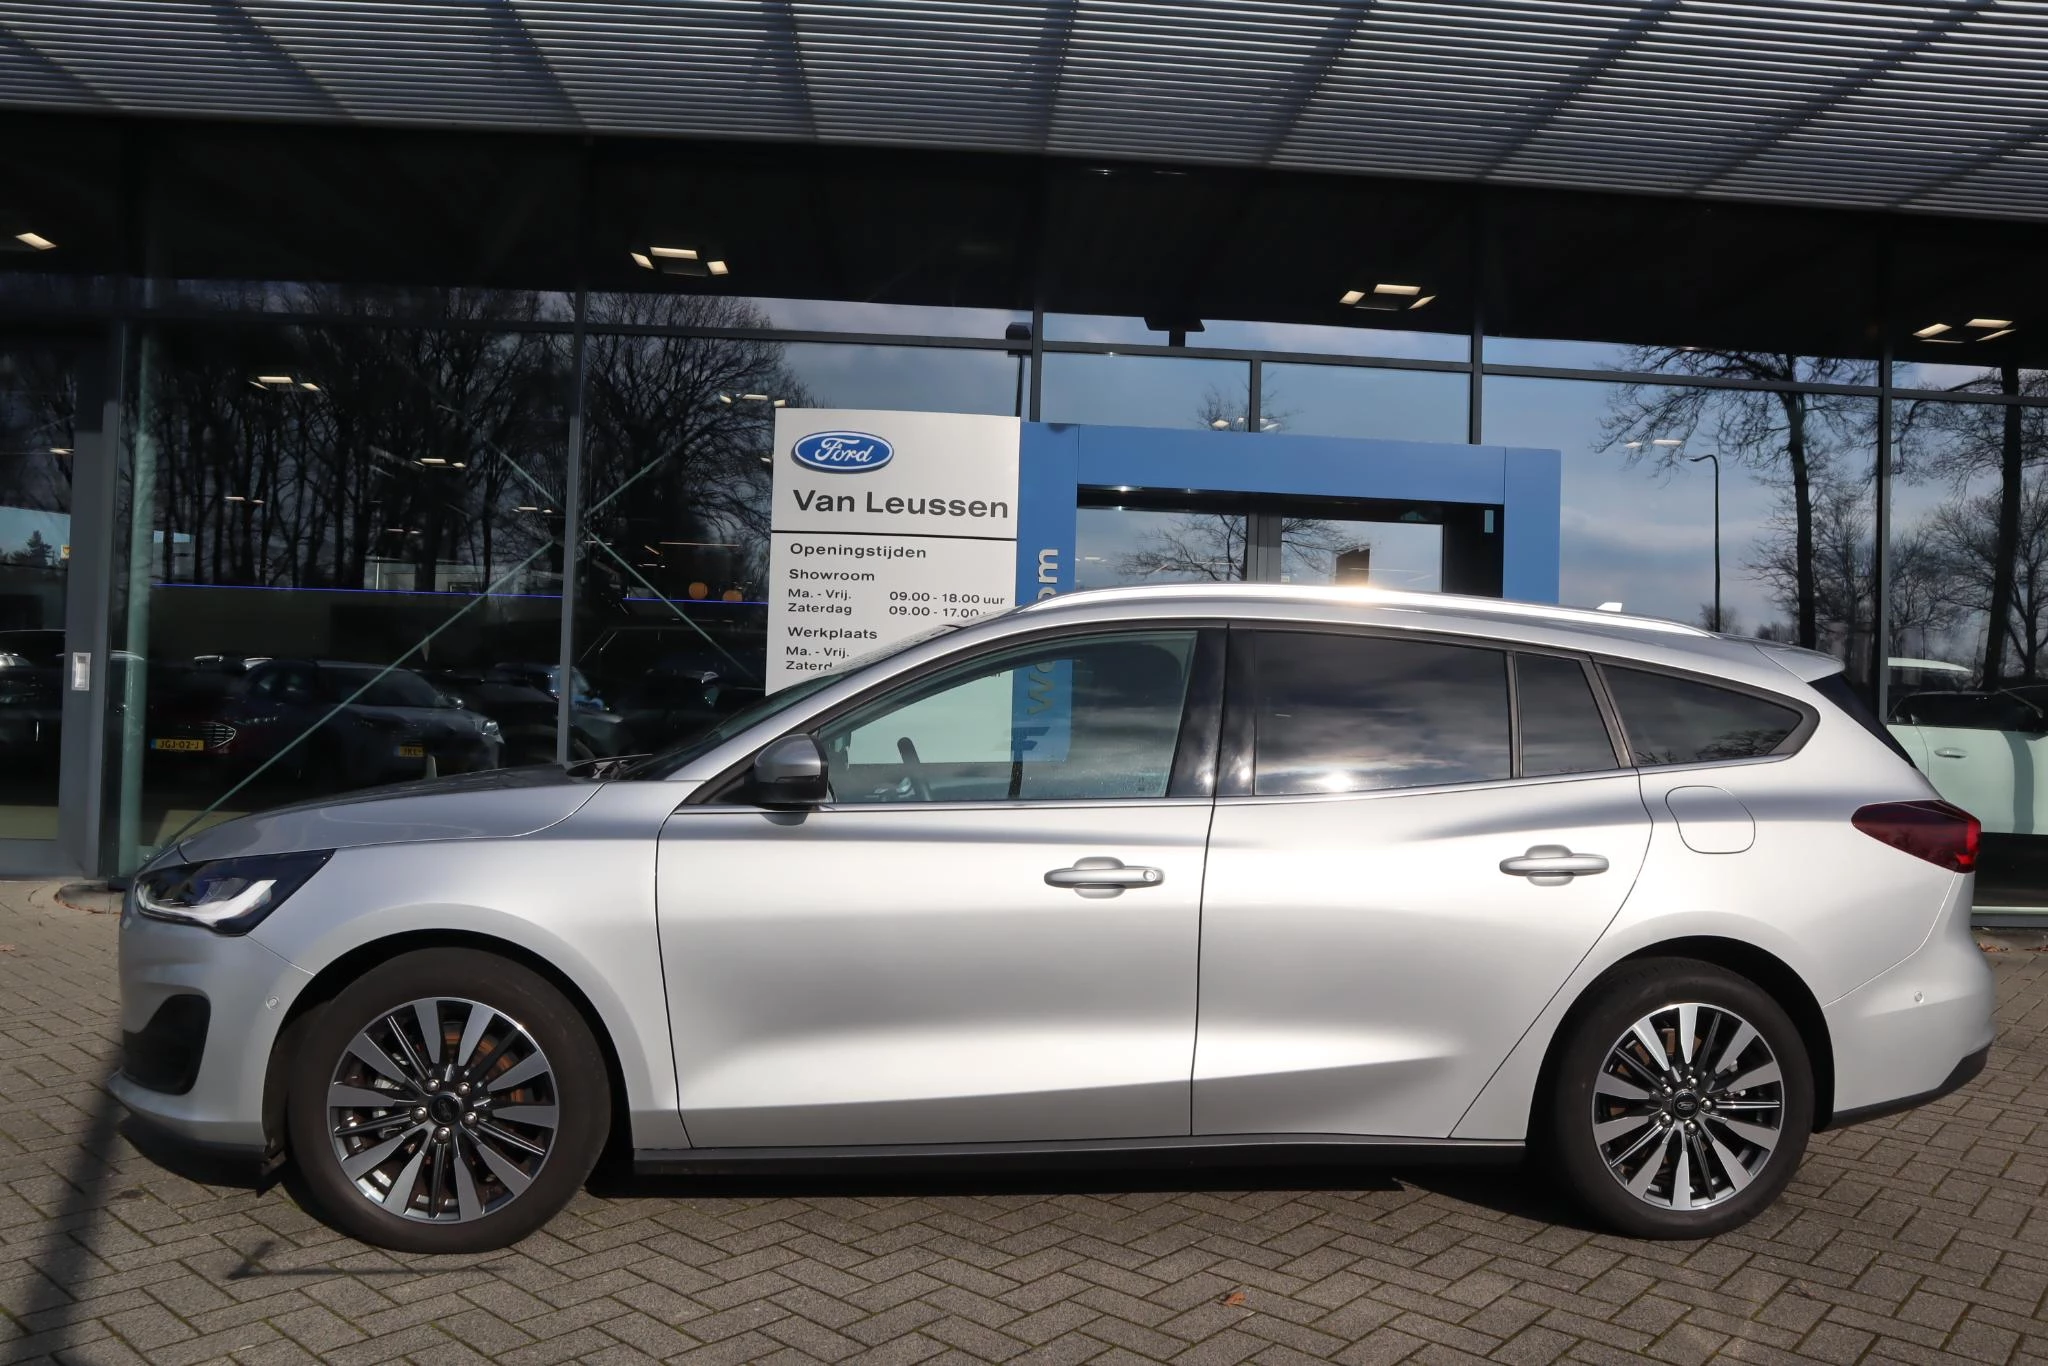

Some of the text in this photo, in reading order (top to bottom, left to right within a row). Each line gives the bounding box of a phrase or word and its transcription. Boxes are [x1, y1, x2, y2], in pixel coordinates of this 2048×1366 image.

[814, 437, 874, 462] Ford
[792, 489, 1008, 519] Van Leussen
[790, 543, 926, 559] Openingstijden
[789, 568, 875, 581] Showroom
[788, 588, 814, 598] Ma.
[825, 589, 852, 601] Vrij.
[889, 591, 930, 602] 09.00
[942, 593, 980, 604] 18.00
[983, 597, 1005, 605] uur
[788, 602, 852, 616] Zaterdag
[888, 606, 930, 616] 09.00
[788, 626, 878, 640] Werkplaats
[786, 646, 812, 656] Ma.
[823, 647, 850, 659] Vrij.
[786, 660, 833, 671] Zaterd
